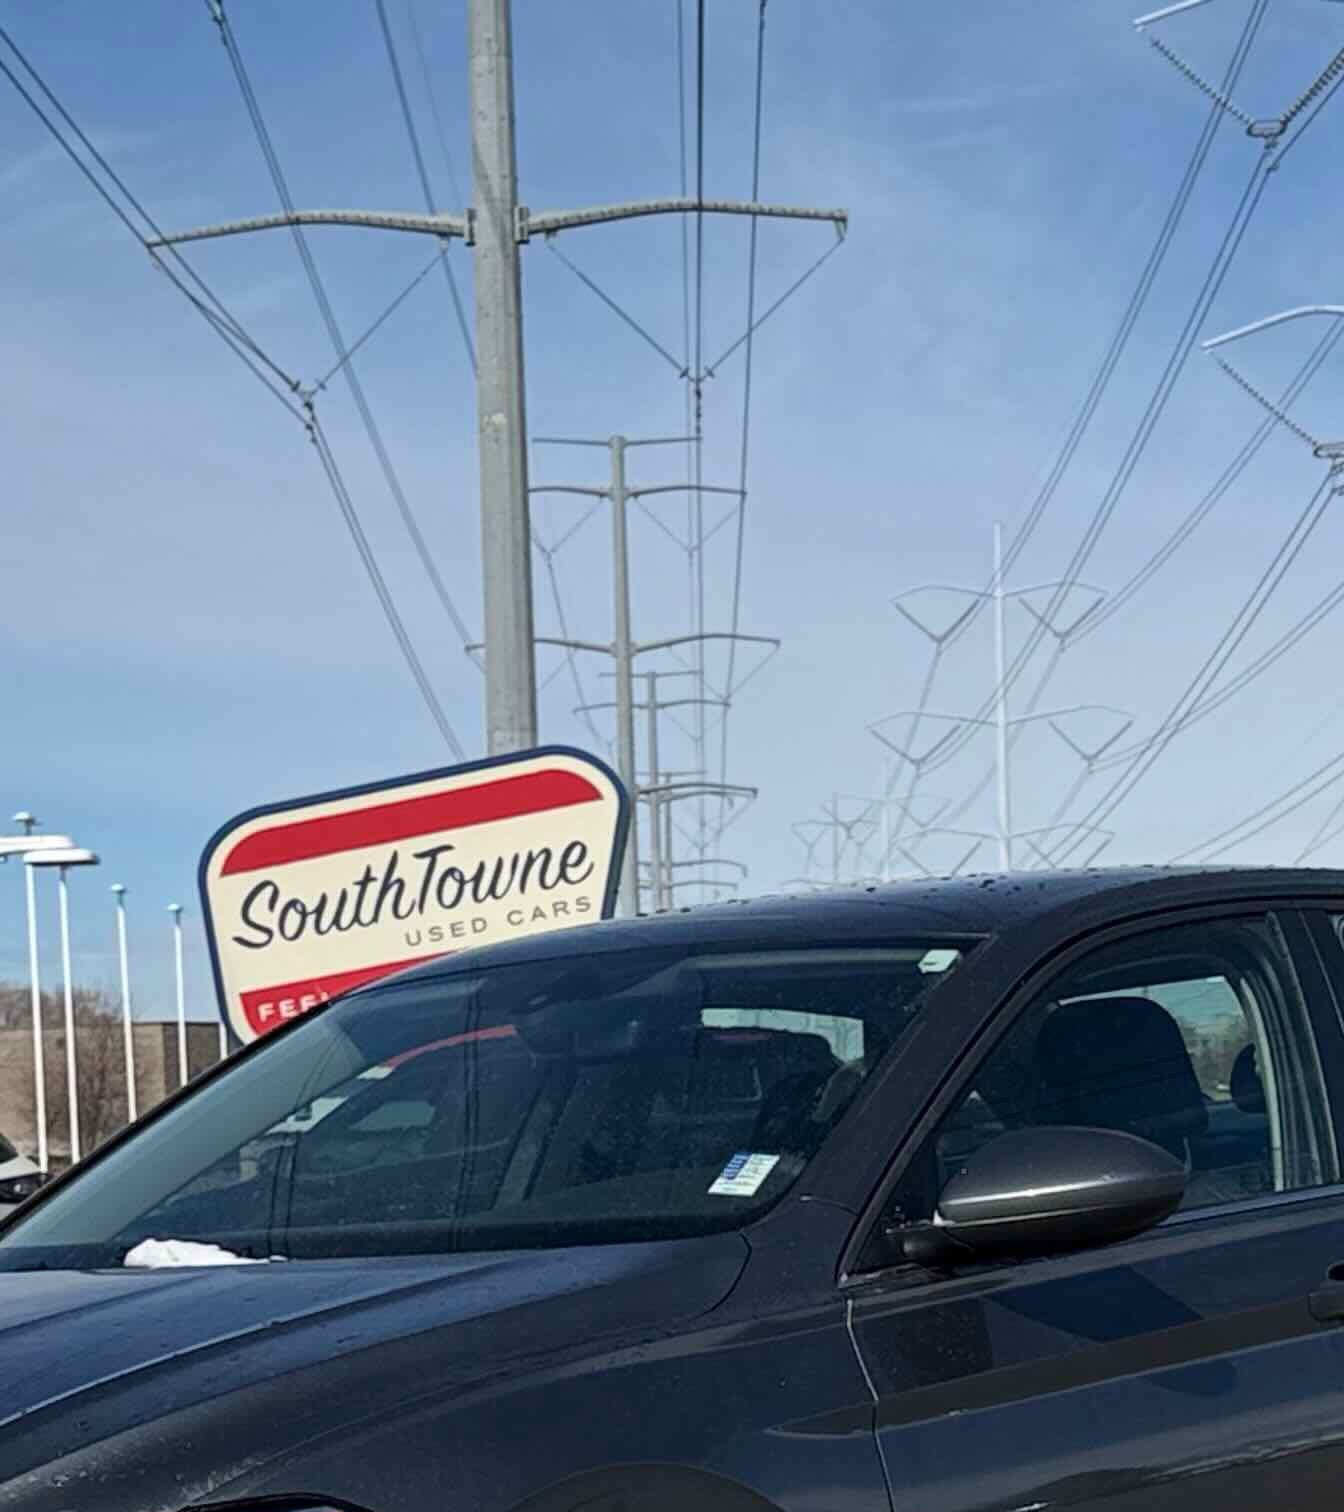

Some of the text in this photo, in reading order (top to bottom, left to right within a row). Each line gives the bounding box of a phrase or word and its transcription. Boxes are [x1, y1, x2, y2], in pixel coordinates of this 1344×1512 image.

[232, 840, 594, 949] SouthTowne
[405, 896, 591, 946] USED CARS
